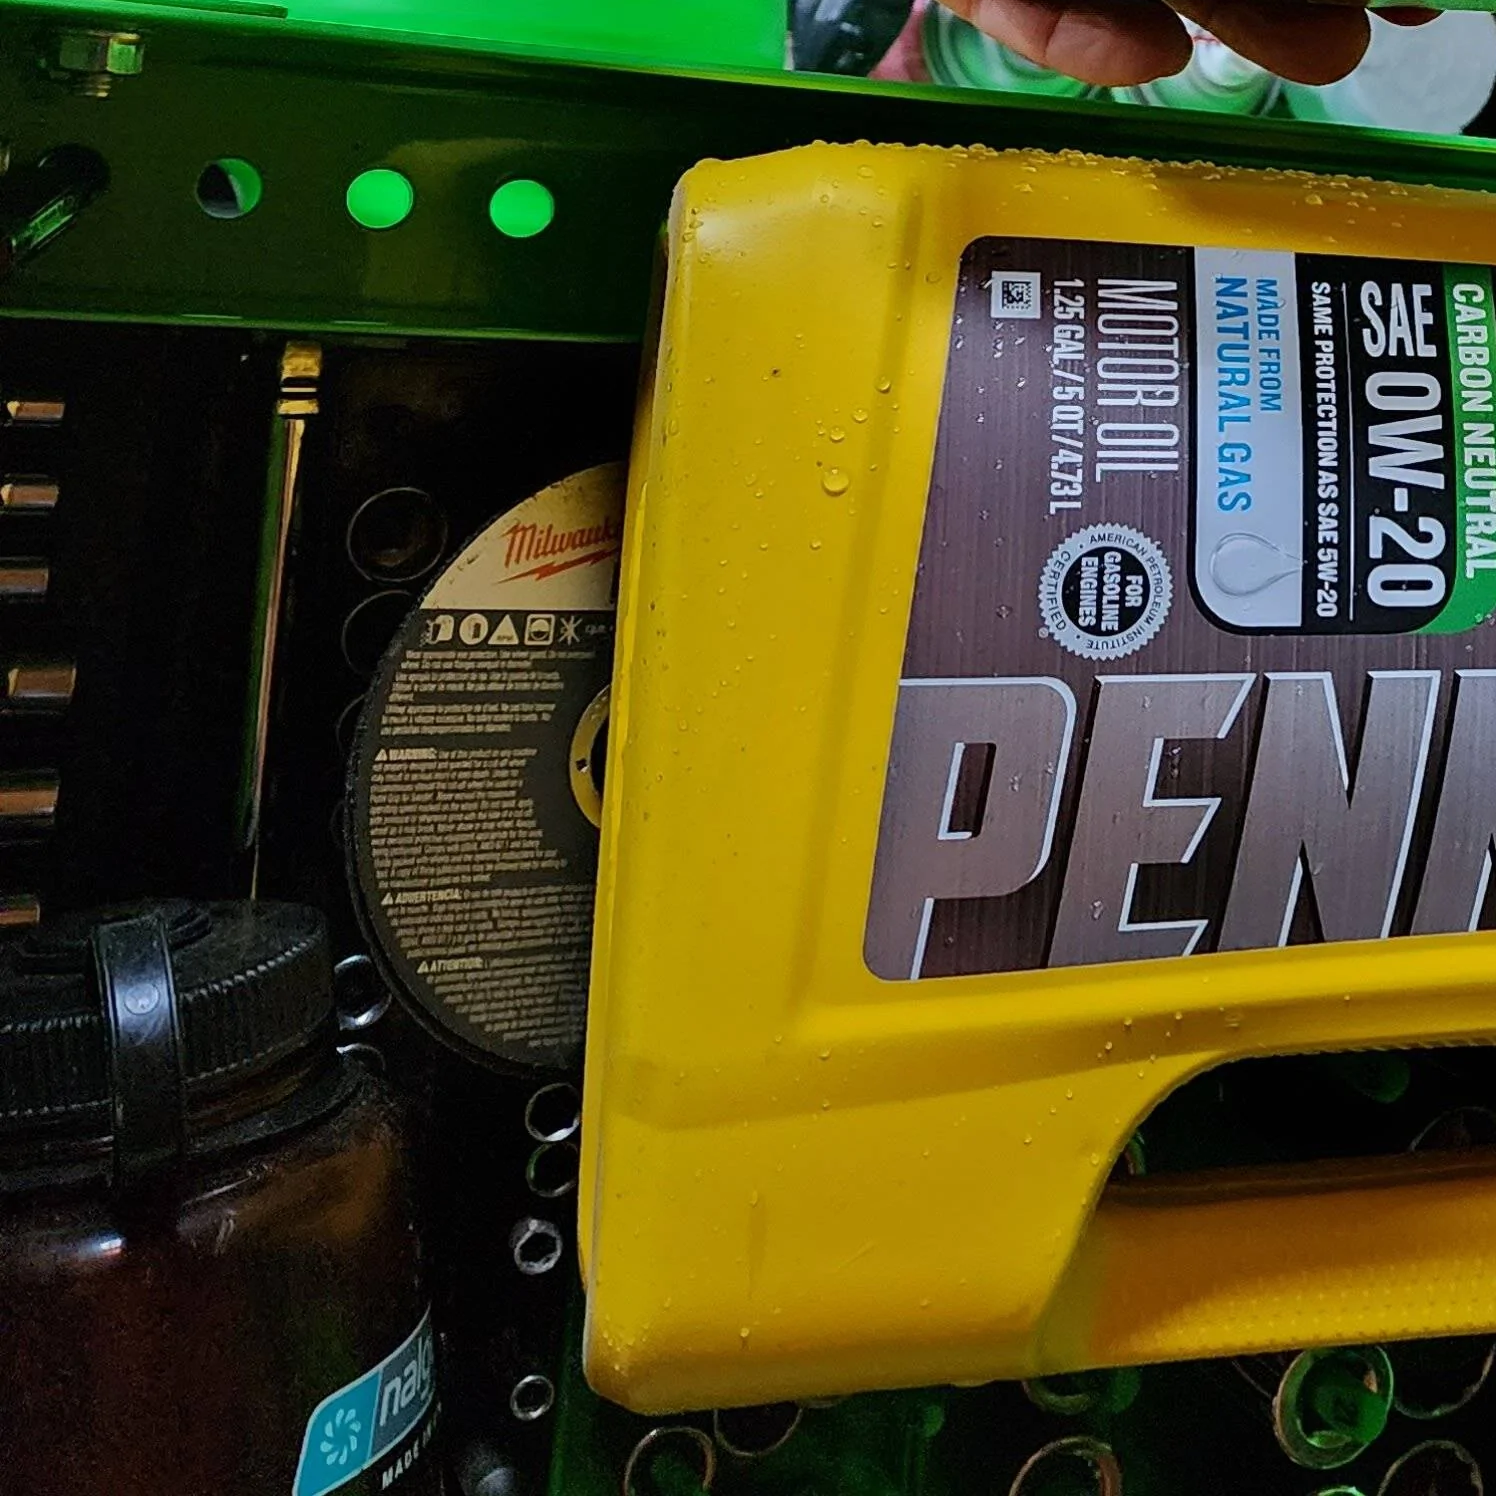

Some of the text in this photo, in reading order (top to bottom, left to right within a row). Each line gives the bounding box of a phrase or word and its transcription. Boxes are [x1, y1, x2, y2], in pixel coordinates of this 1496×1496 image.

[1053, 278, 1085, 320] 1.25
[1255, 278, 1282, 411] MADE FROM
[1452, 282, 1494, 413] CARBON
[1095, 278, 1180, 483] MOTOR OIL
[1215, 277, 1253, 512] NATURAL GAS
[1311, 281, 1339, 618] SAME PROTECTION AS SAE 5W-20
[1360, 280, 1446, 608] SAE 0W-20
[1046, 550, 1071, 632] CERTIFIED
[1078, 556, 1099, 627] ENGINES
[1086, 532, 1164, 650] AMERICAN PETROLEUM INSTITUTE
[1101, 550, 1122, 632] GASOLINE
[1124, 575, 1144, 608] FOR
[381, 1434, 420, 1490] MADE
